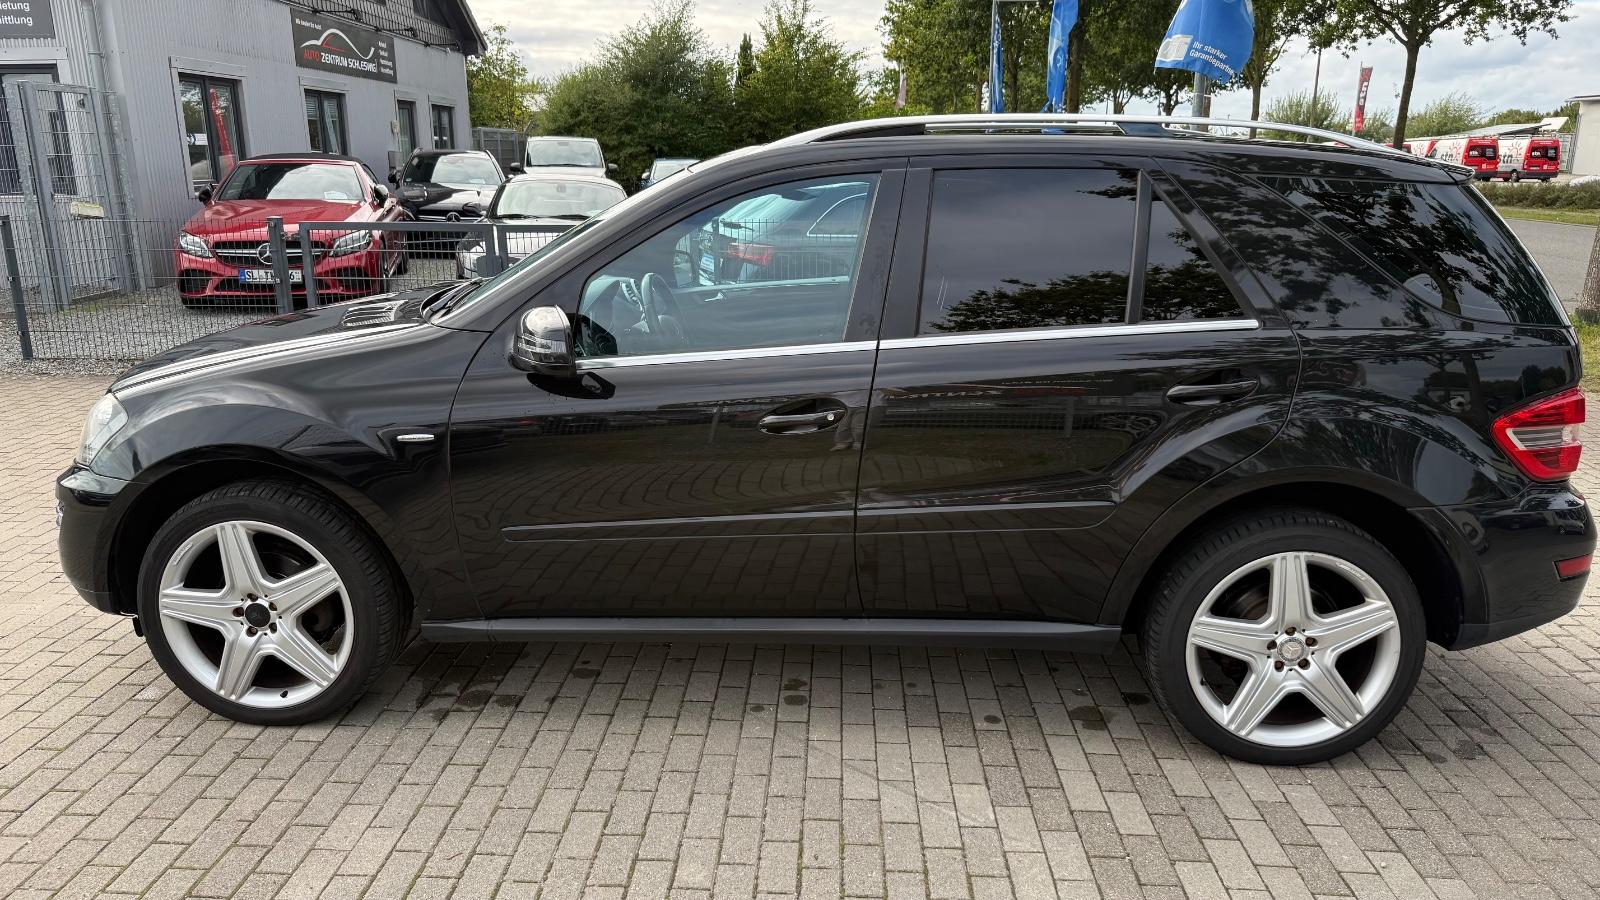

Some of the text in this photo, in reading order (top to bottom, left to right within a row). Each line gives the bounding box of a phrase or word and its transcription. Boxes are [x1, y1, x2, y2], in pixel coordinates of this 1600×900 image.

[304, 49, 321, 62] AUTO
[321, 52, 348, 67] ZENTRUM
[1192, 41, 1203, 49] Ihr
[1203, 45, 1228, 60] starker
